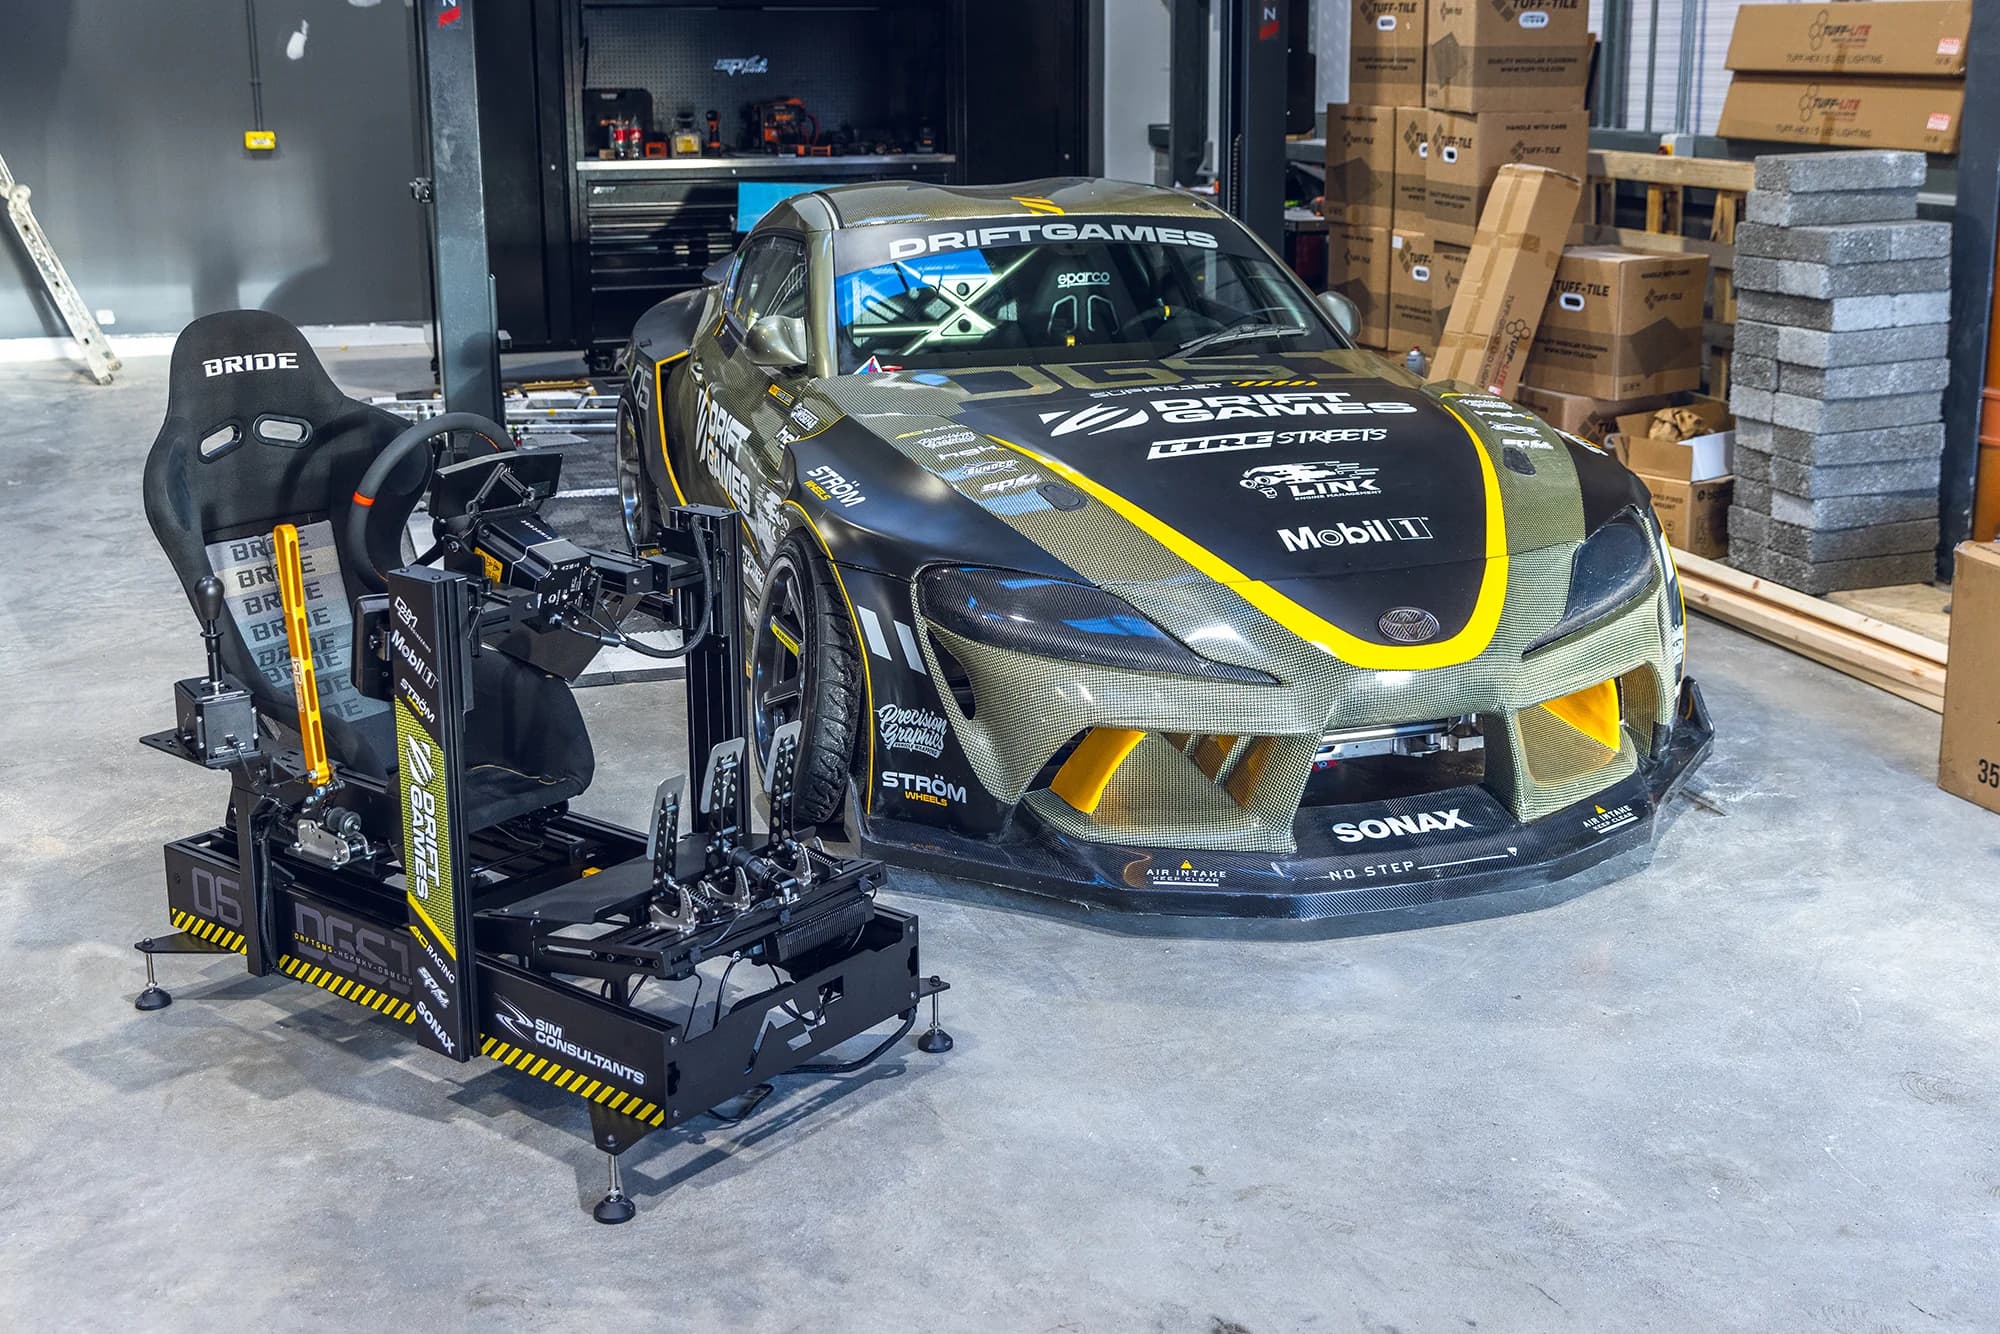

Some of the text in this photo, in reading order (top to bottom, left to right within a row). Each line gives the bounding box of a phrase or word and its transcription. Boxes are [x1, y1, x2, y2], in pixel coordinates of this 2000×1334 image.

[888, 223, 1218, 261] DRIFTGAMES
[1554, 280, 1610, 297] TUFF-TILE
[202, 352, 299, 378] BRIDE
[1149, 392, 1352, 412] DRIFT
[1161, 401, 1419, 424] GAMES
[708, 399, 752, 462] DRIFT
[1275, 428, 1388, 445] STREETS
[706, 438, 751, 514] GAMES
[807, 465, 866, 508] STRÖM
[1288, 479, 1381, 497] LINK
[1277, 519, 1392, 552] Mobil
[391, 629, 425, 676] Mobil
[400, 678, 436, 723] STRÖM
[875, 704, 947, 736] Precision
[880, 723, 945, 751] Graphics
[882, 770, 967, 804] STRÖM
[904, 791, 948, 807] WHEELS
[1332, 809, 1474, 843] SONAX
[1583, 804, 1633, 828] AIR INTAKE
[411, 784, 429, 900] GAMES
[422, 790, 440, 888] DRIFT
[1146, 868, 1227, 878] AIR INTAKE
[1328, 861, 1415, 882] NO STEP
[192, 866, 243, 928] 05
[425, 944, 455, 984] RACING
[416, 1000, 455, 1054] SONAX
[535, 1018, 563, 1039] SIM
[535, 1030, 646, 1086] CONSULTANTS
